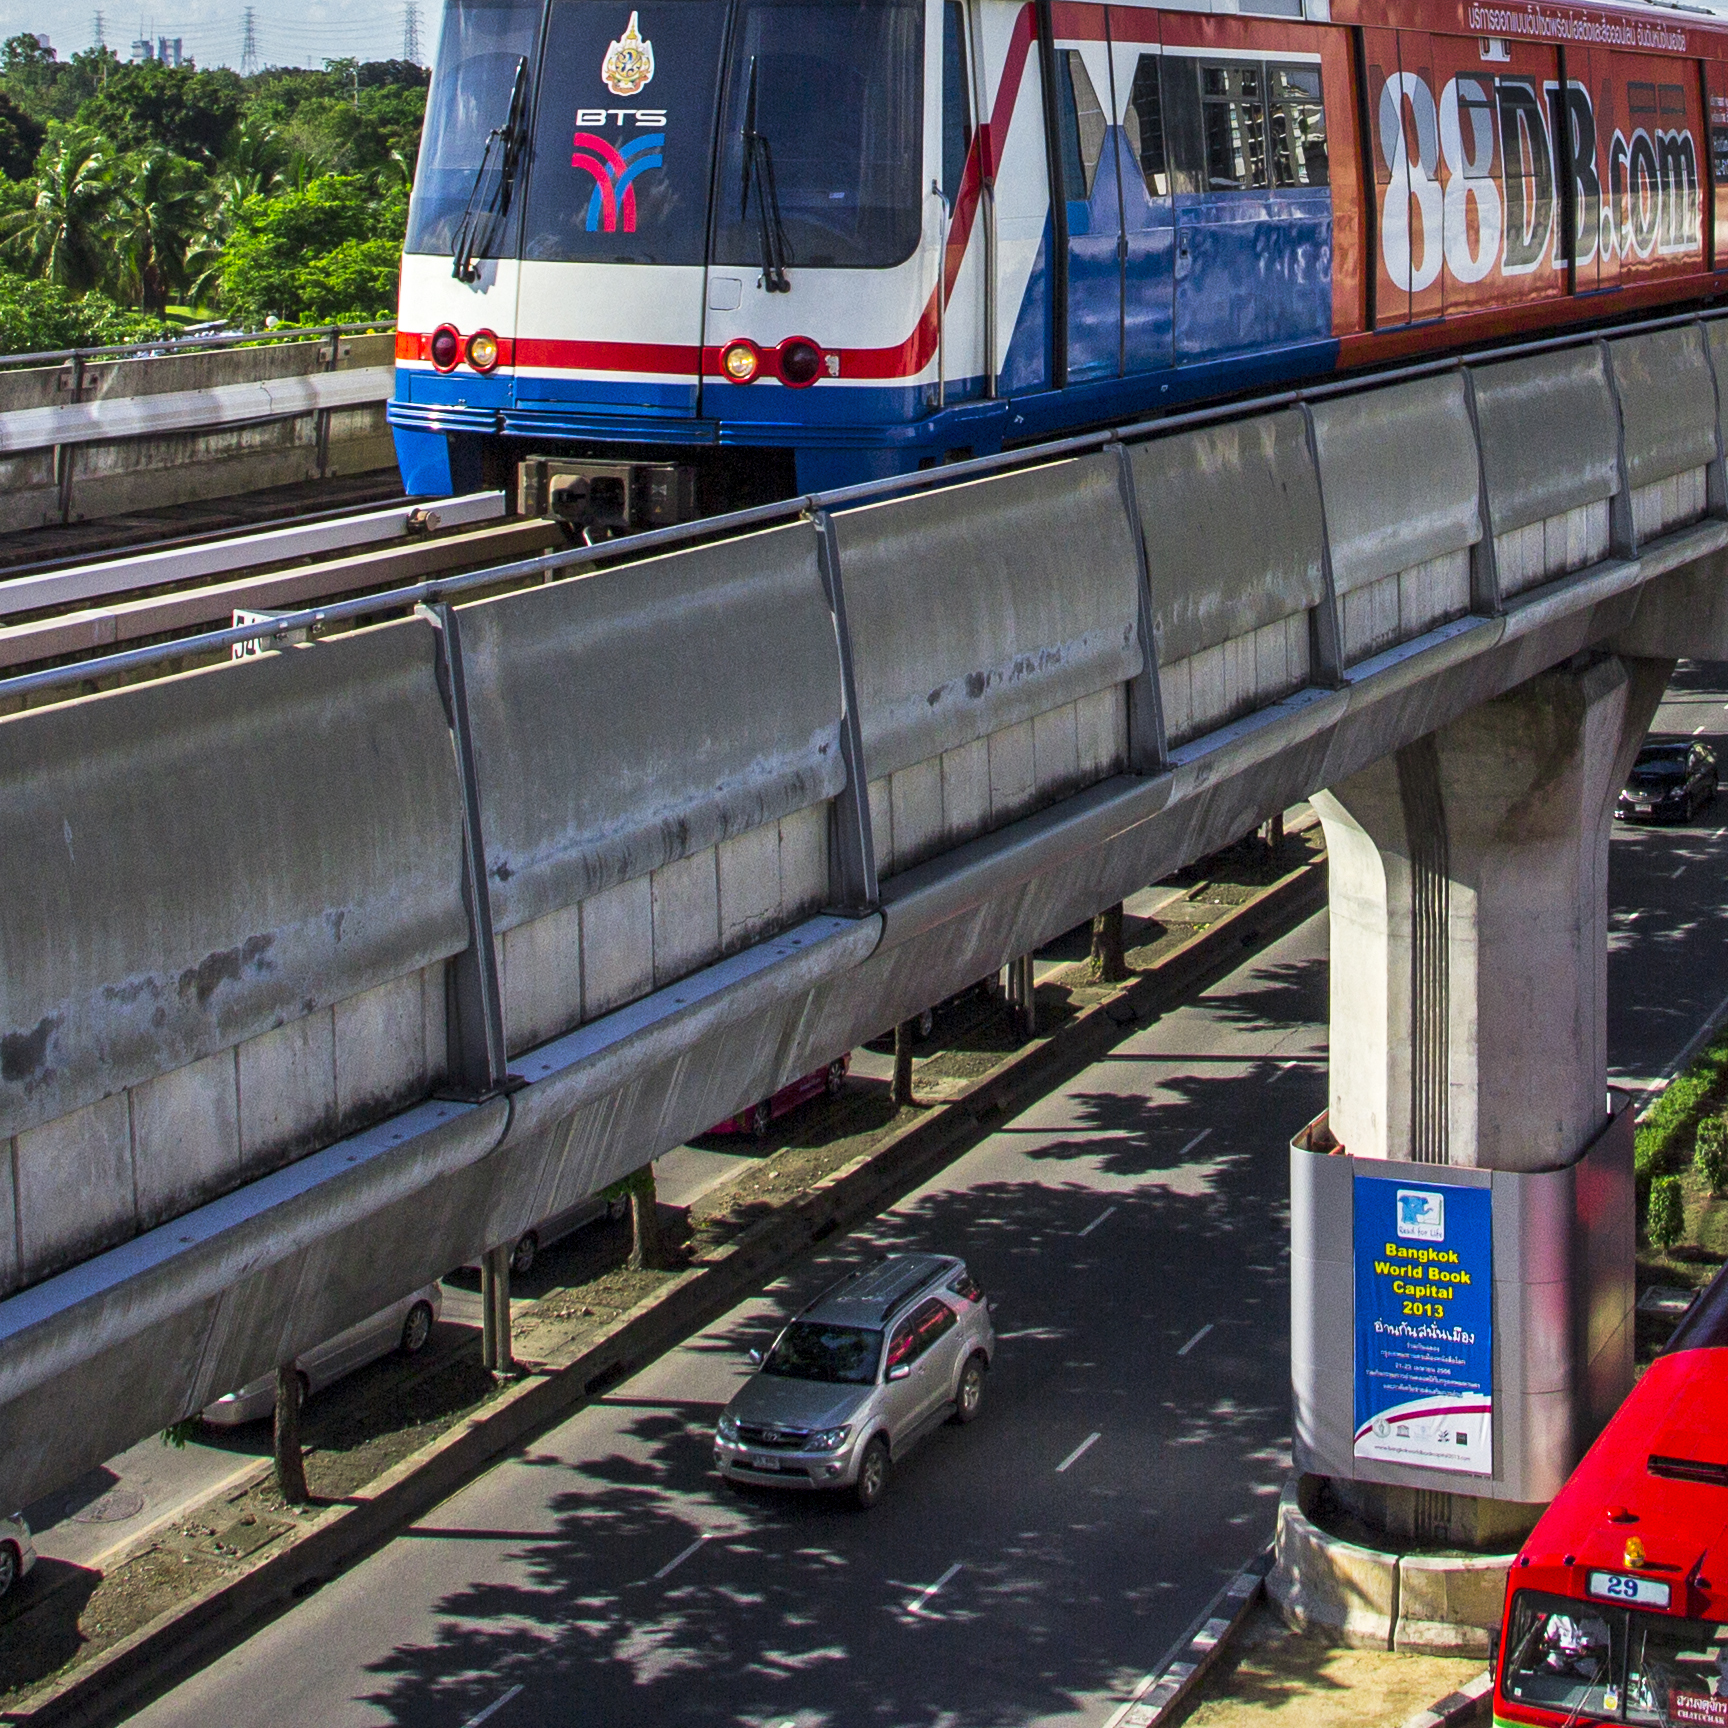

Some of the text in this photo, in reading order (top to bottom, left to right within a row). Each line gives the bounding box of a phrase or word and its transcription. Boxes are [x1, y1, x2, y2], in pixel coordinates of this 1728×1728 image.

[575, 108, 668, 127] BTS
[1378, 71, 1700, 292] 88DB.com
[1417, 1227, 1428, 1237] for
[1385, 1242, 1459, 1264] Bangkok
[1374, 1261, 1471, 1284] World Book
[1393, 1280, 1453, 1300] Capital
[1402, 1301, 1444, 1318] 2013
[1607, 1575, 1639, 1598] 29
[1676, 1695, 1728, 1714] สวนจตุจักร
[1677, 1709, 1725, 1725] CHATUCHAK
